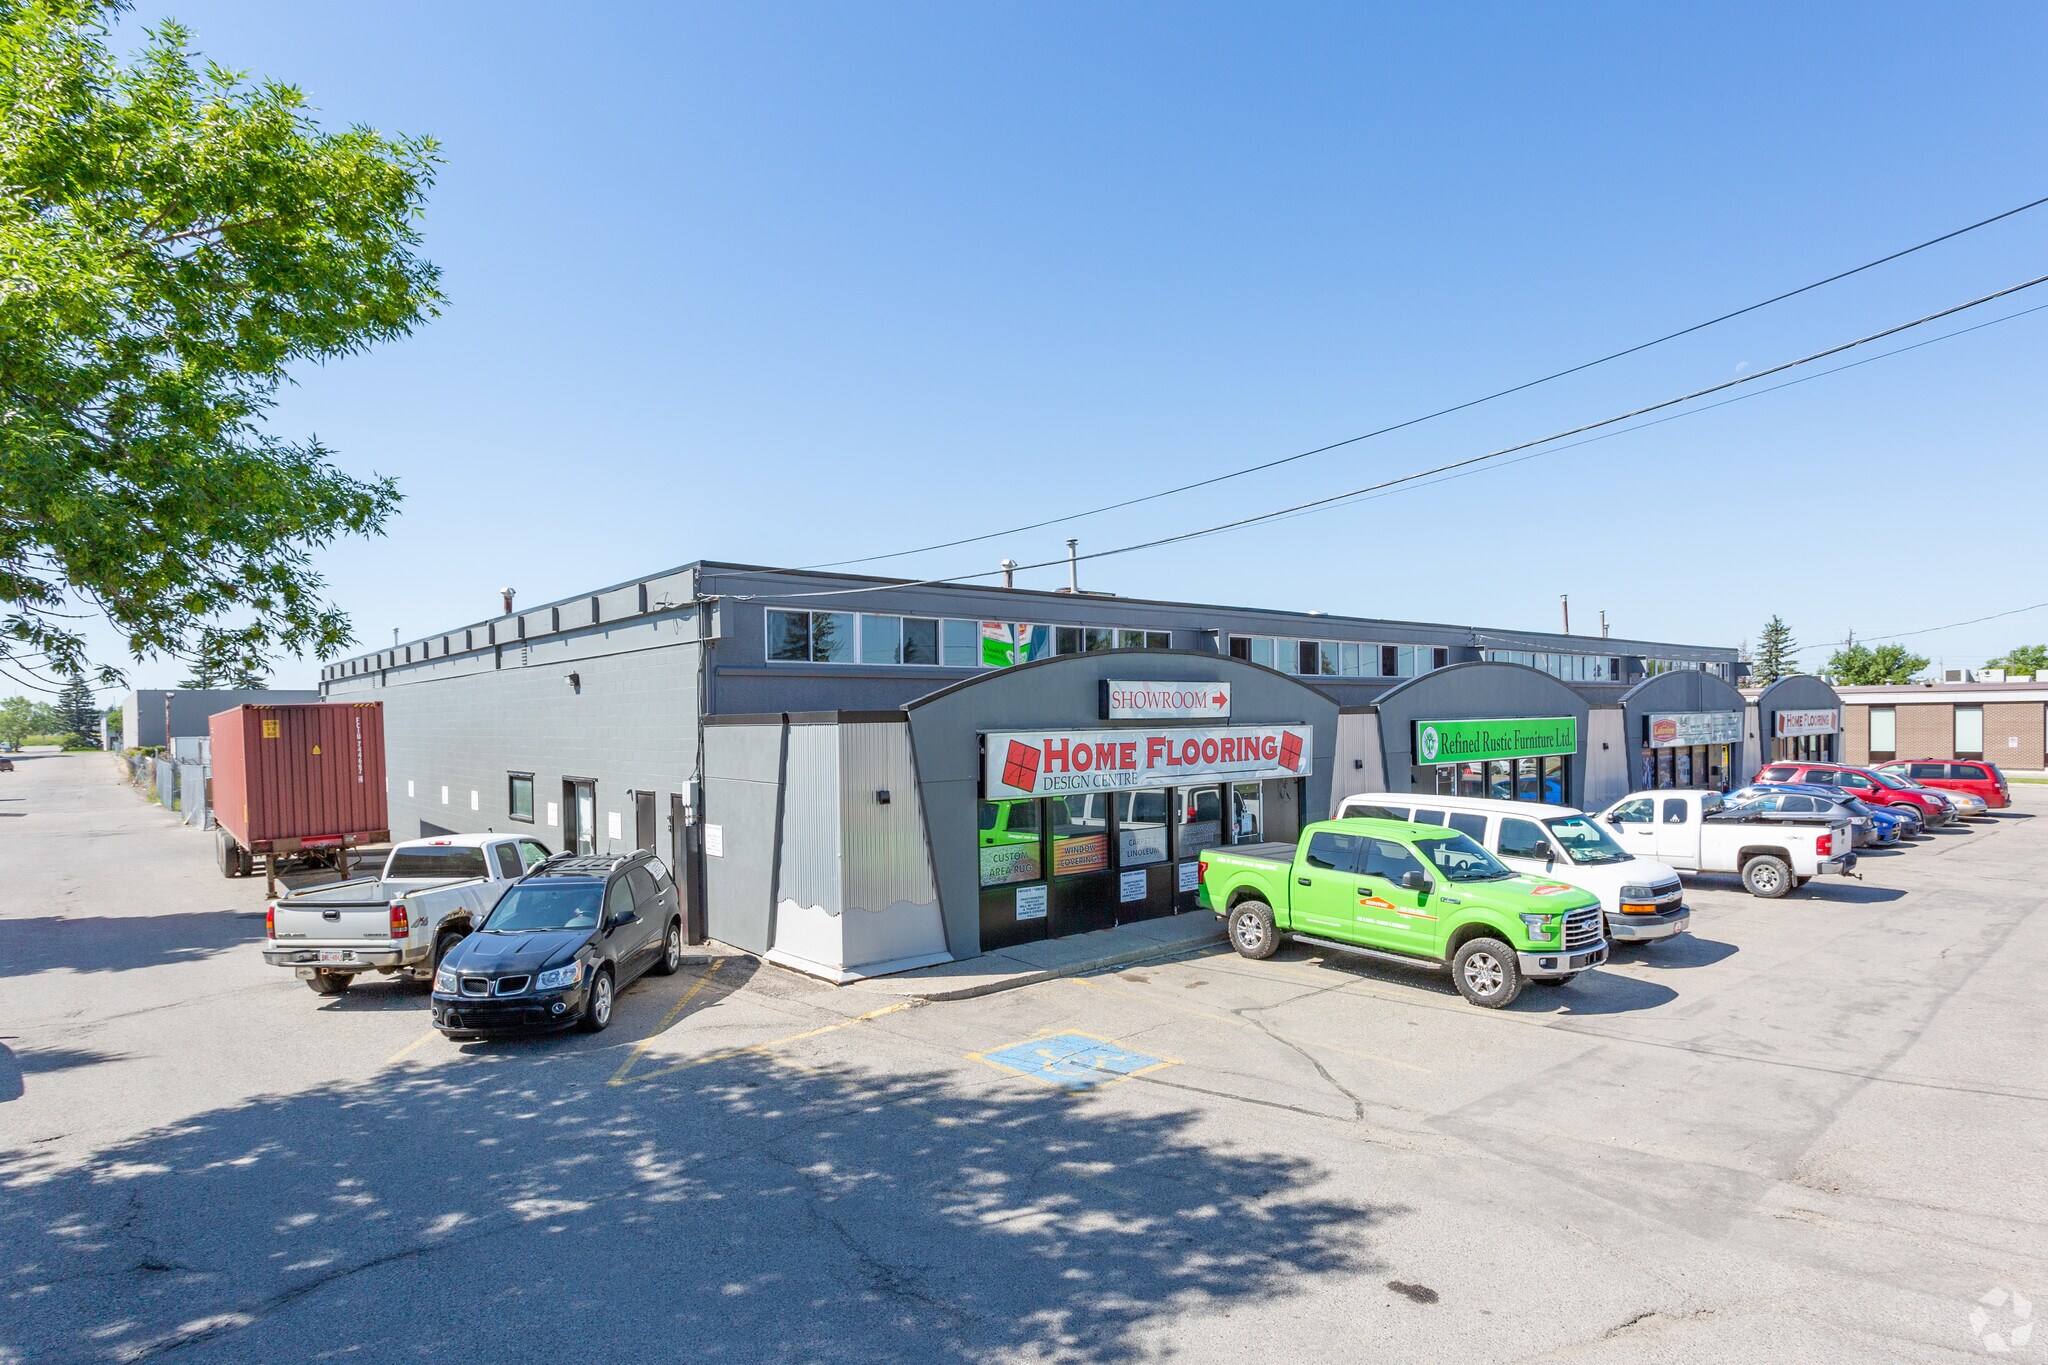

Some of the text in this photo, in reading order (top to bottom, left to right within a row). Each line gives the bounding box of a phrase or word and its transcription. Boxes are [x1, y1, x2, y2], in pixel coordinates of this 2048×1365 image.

[1112, 690, 1207, 710] SHOWROOM
[1441, 727, 1573, 755] Refined Rustic Furniture Ltd.
[1043, 735, 1278, 773] HOME FLOORING
[1043, 772, 1138, 791] DESIGN CENTRE
[1128, 837, 1152, 847] CARPET
[1064, 844, 1097, 855] WINDOW
[1126, 847, 1160, 858] LINOLEUM
[993, 851, 1029, 863] CUSTOM
[1060, 854, 1101, 867] COVERINGS
[989, 863, 1033, 878] AREA RUG
